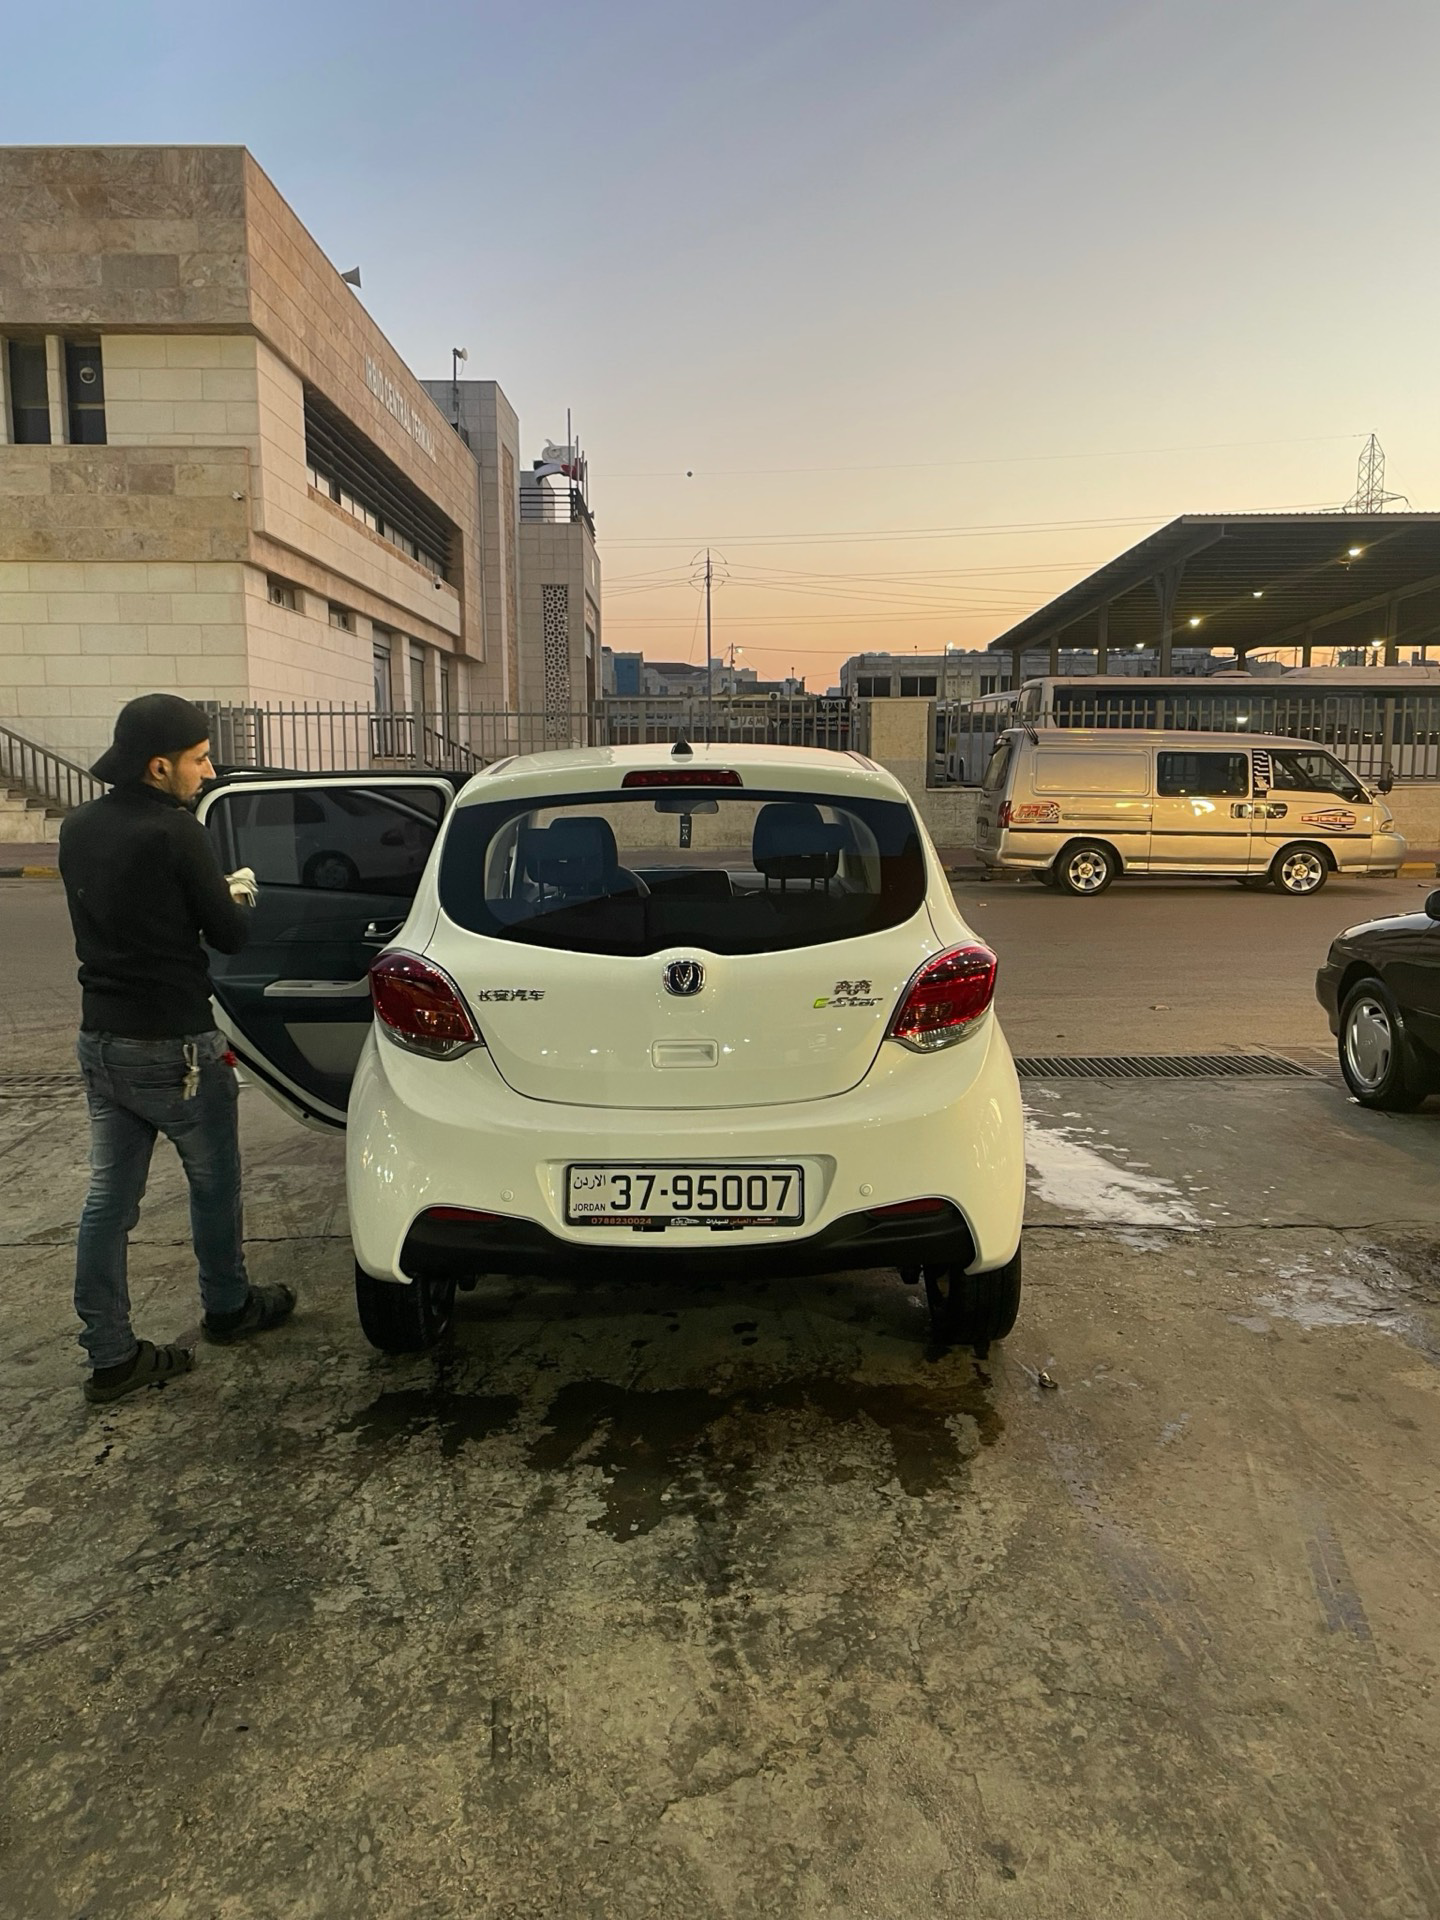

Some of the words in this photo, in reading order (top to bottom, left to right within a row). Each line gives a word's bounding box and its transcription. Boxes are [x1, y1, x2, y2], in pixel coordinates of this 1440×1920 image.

[364, 352, 384, 404] IRBID
[384, 376, 412, 436] CENTRAL
[610, 1174, 793, 1212] 37-95007
[573, 1203, 606, 1212] JORDAN
[591, 1217, 652, 1225] 0788230024
[705, 1218, 729, 1226] للسيارات
